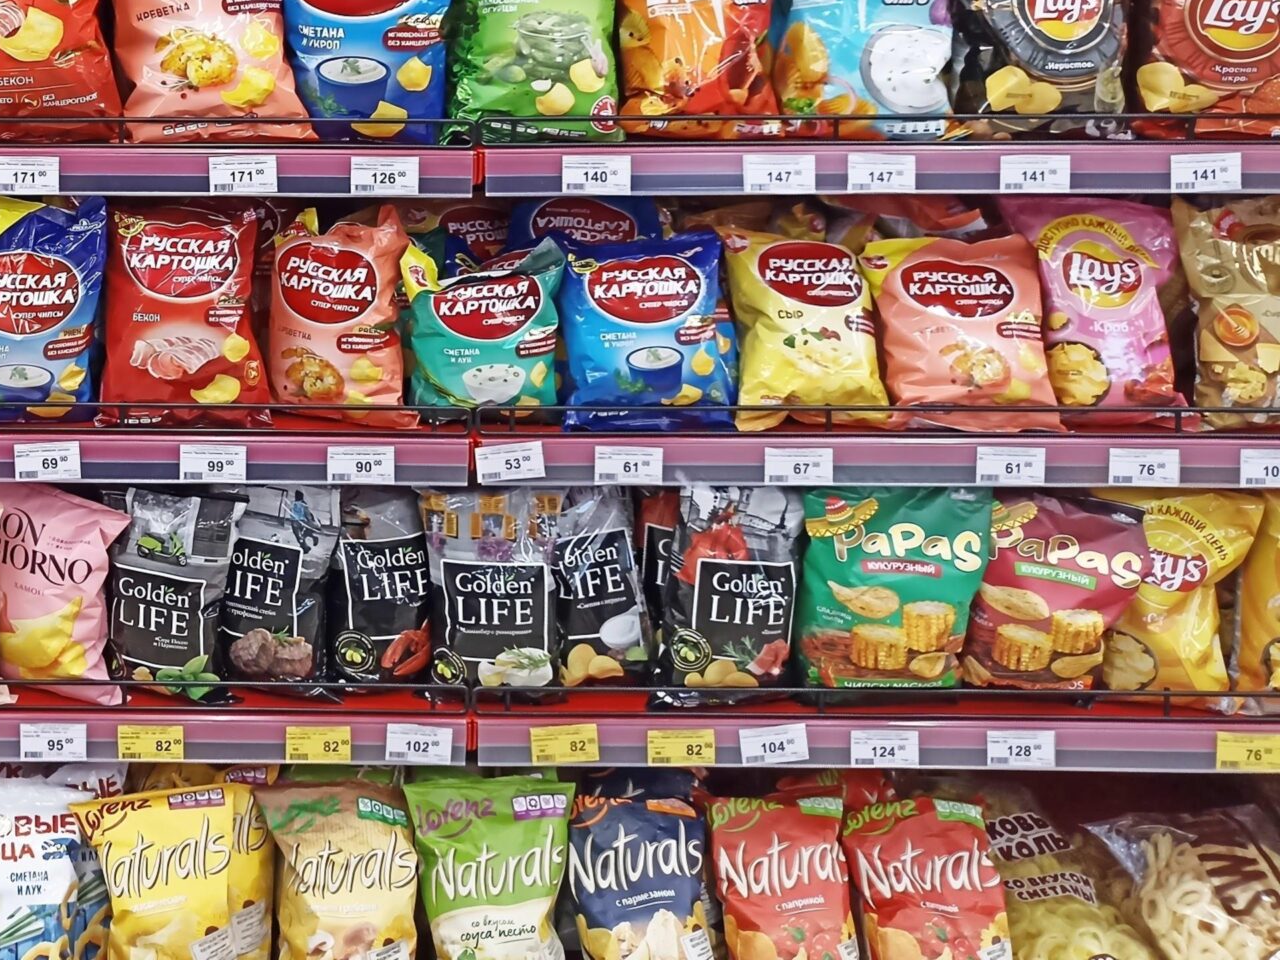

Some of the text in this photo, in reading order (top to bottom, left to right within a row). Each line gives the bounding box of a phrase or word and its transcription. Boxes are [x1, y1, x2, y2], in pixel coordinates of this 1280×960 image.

[13, 172, 34, 183] 171
[231, 171, 252, 182] 171
[372, 173, 395, 184] 126
[584, 171, 607, 182] 140
[1023, 171, 1044, 181] 141
[1193, 169, 1215, 180] 141
[287, 256, 367, 282] РУССКАЯ
[601, 267, 686, 281] РУССКАЯ
[913, 271, 996, 283] РУССКАЯ
[281, 272, 374, 300] КАРТОШКА
[909, 283, 1011, 296] КАРТОШКА
[778, 309, 803, 319] СЫР
[356, 462, 371, 472] 90
[1006, 463, 1020, 474] 61
[1139, 465, 1155, 475] 76
[456, 598, 533, 624] LIFE
[118, 604, 190, 636] LIFE
[48, 740, 63, 751] 95
[406, 741, 429, 752] 102
[762, 741, 785, 753] 104
[569, 822, 702, 893] Naturals
[432, 824, 564, 907] Naturals
[783, 896, 825, 910] паприкой
